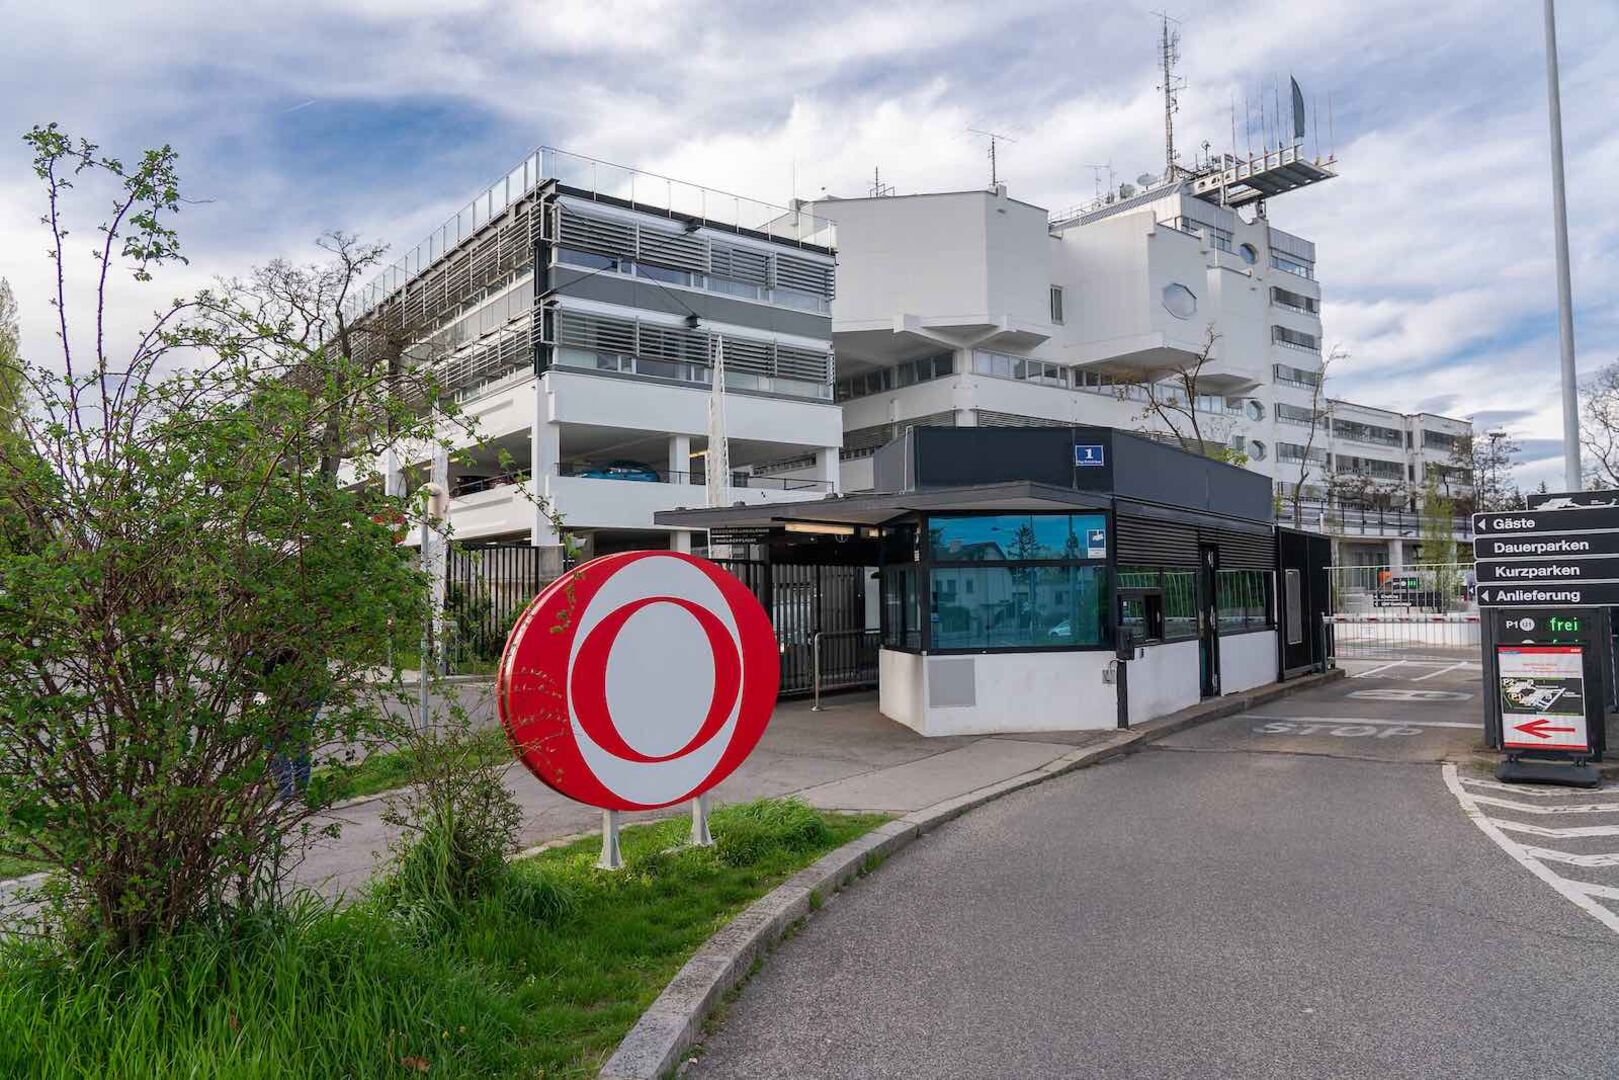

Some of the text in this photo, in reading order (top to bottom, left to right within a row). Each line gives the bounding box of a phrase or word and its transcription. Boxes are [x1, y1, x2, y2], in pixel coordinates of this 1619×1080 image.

[1085, 448, 1093, 459] 1
[1493, 518, 1535, 530] Gäste
[1494, 540, 1589, 554] Dauerparken
[1495, 565, 1580, 578] Kurzparken
[1496, 590, 1581, 602] Anlieferung
[1550, 617, 1578, 632] frei
[1252, 722, 1424, 738] STOP
